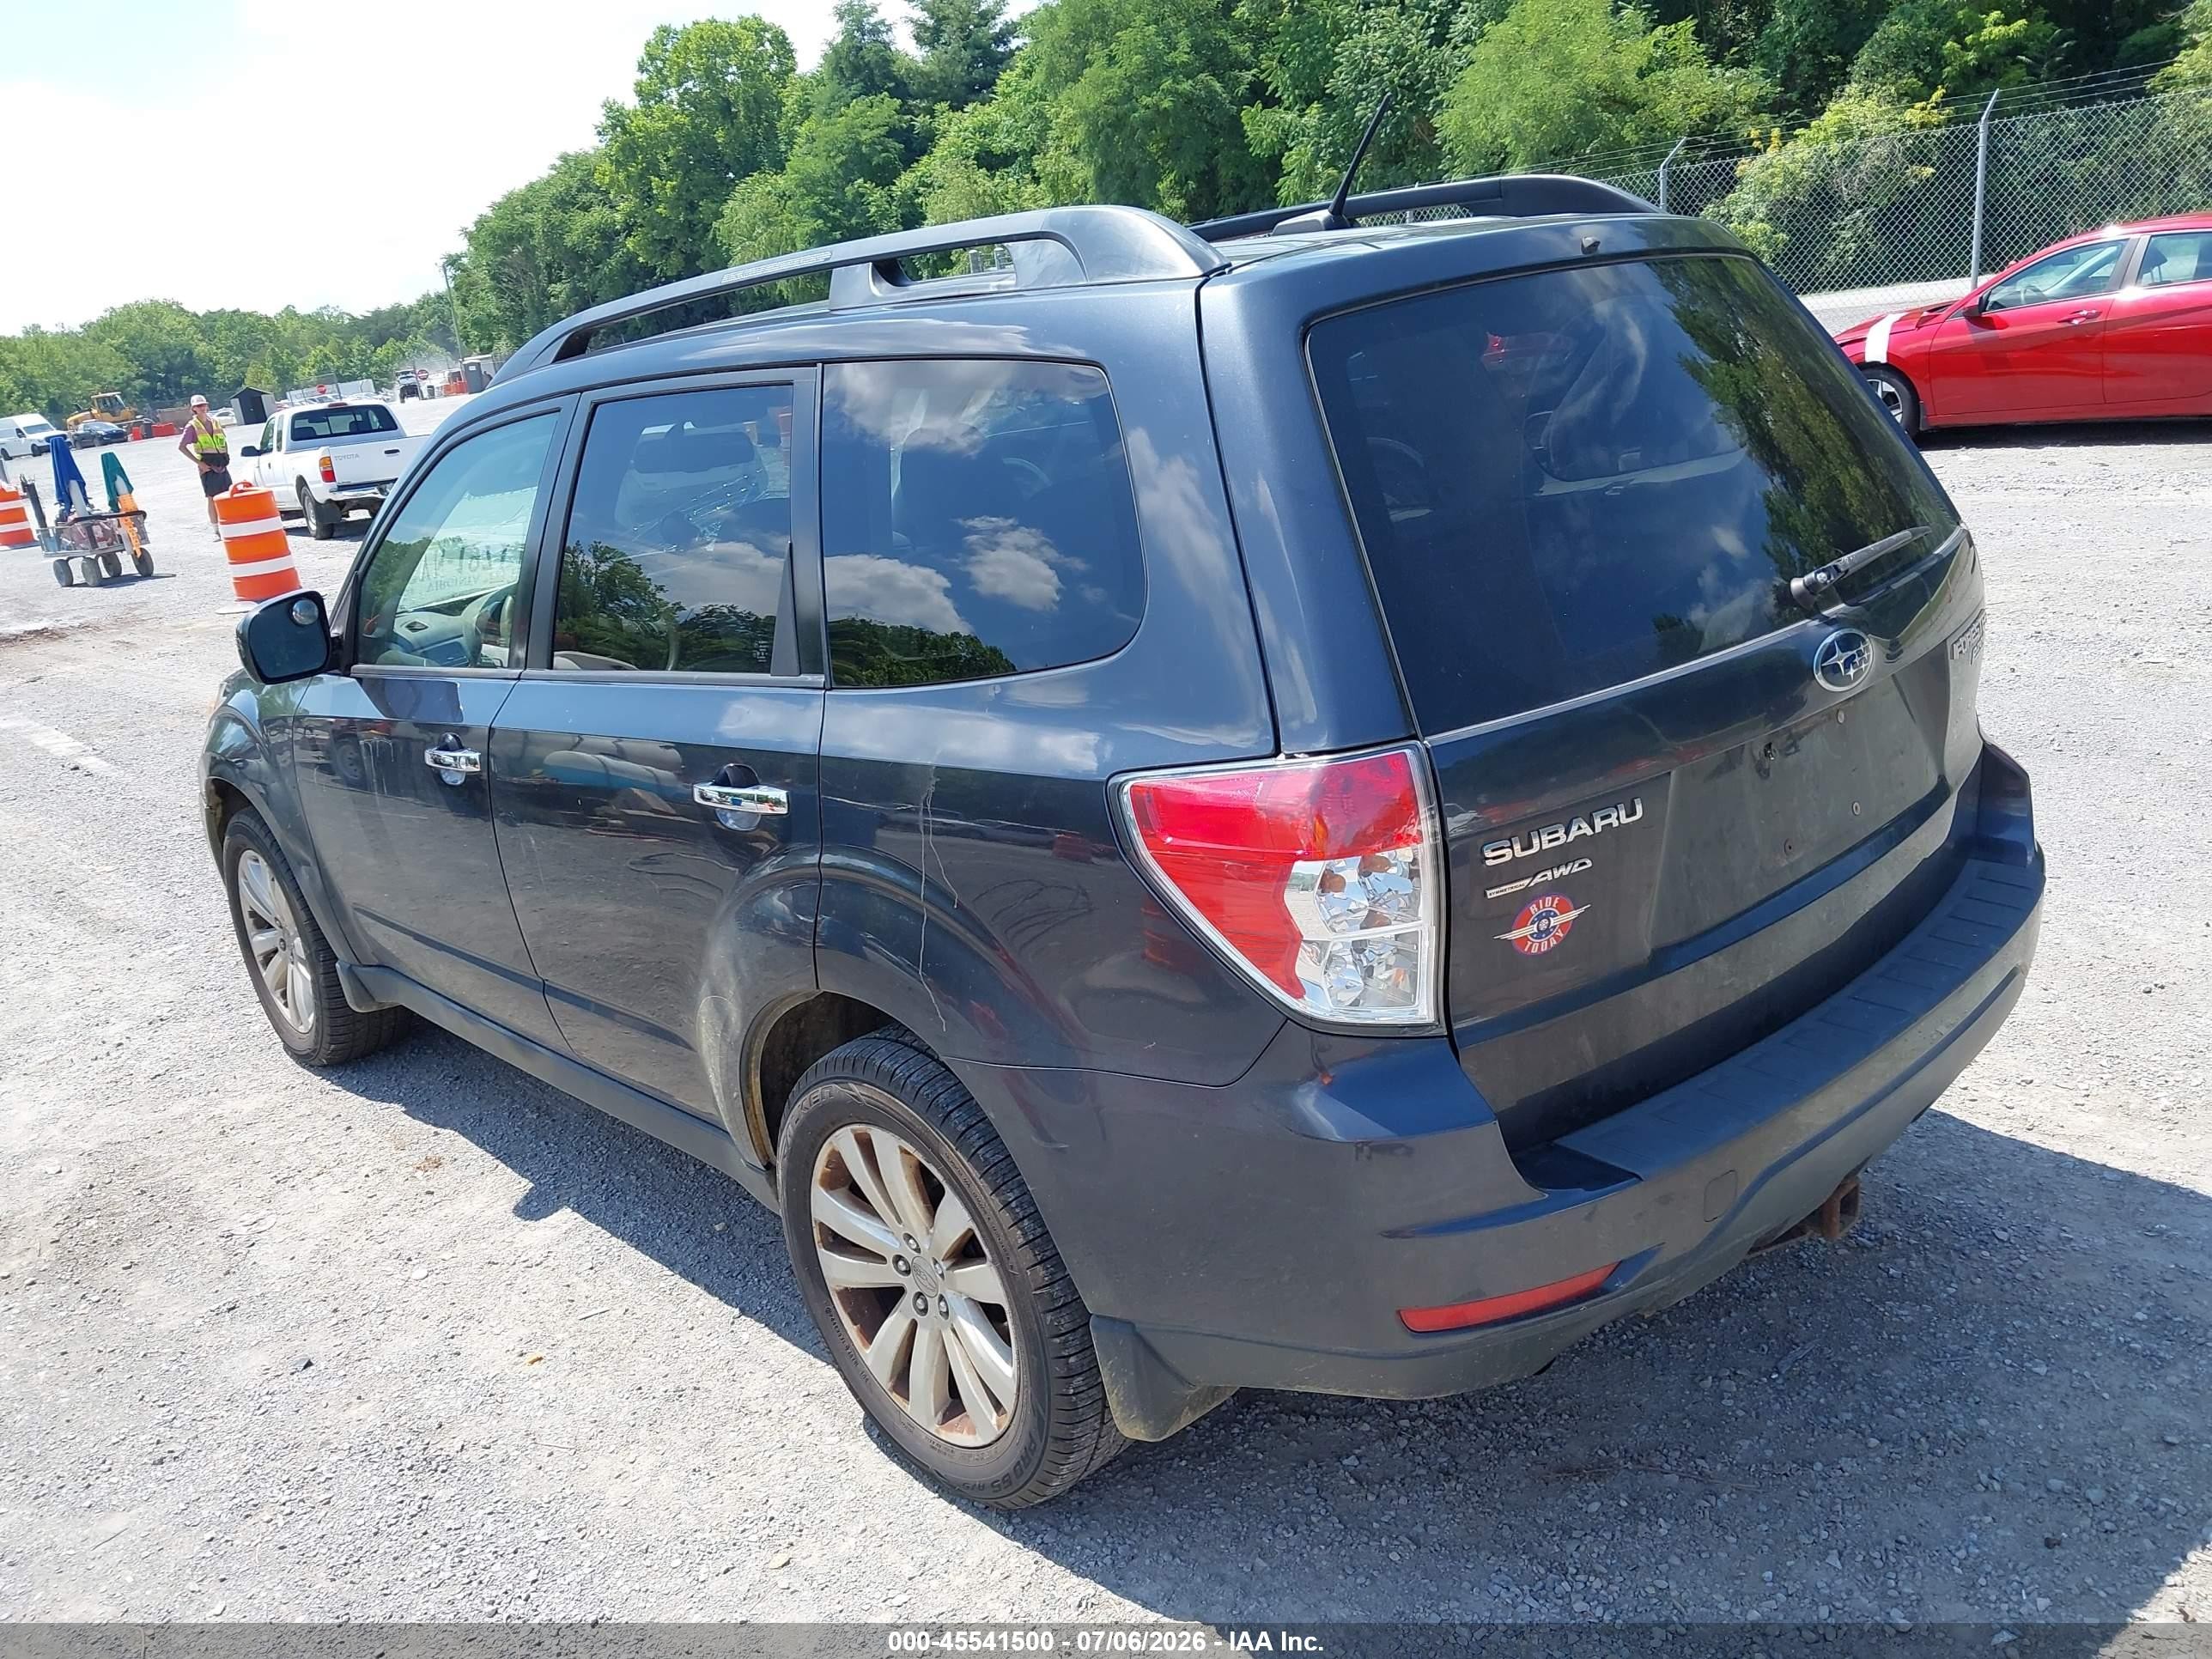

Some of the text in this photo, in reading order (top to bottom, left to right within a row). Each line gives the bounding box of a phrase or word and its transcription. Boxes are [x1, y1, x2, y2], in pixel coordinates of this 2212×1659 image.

[334, 453, 360, 461] TOYOTA
[1483, 798, 1644, 866] SUBARU
[1529, 857, 1593, 887] AWD
[1528, 896, 1559, 915] RIDE
[1525, 929, 1565, 954] TODAY
